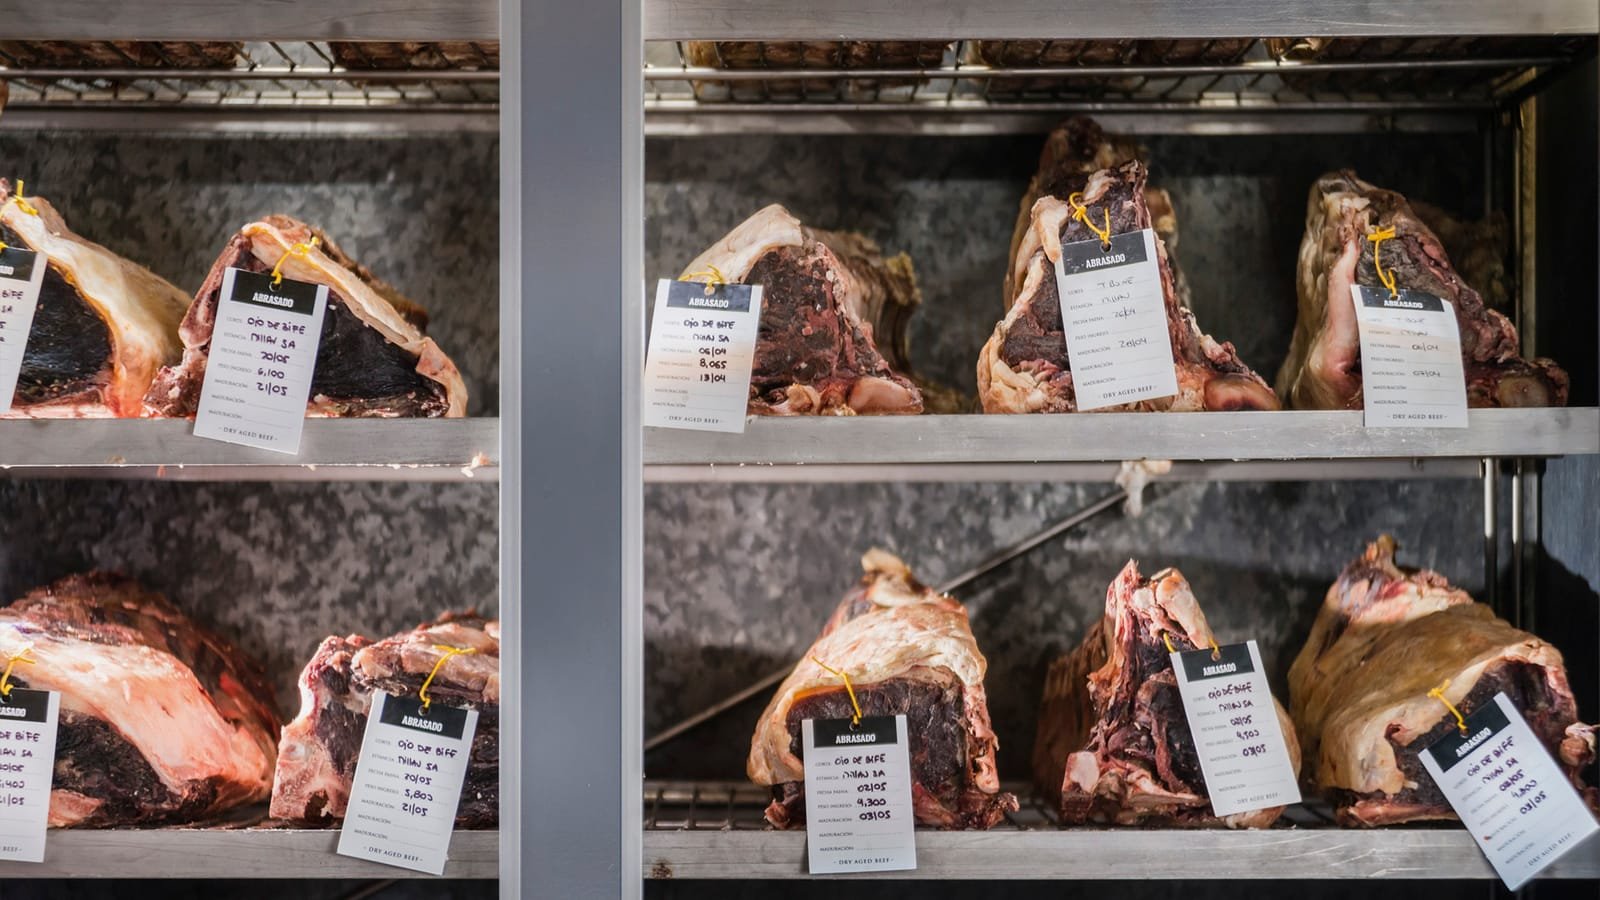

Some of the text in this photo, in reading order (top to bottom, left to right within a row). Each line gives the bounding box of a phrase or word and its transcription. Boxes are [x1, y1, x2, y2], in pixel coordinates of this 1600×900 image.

[1086, 254, 1126, 268] ABRASADO
[252, 292, 294, 308] ABRASADO
[689, 298, 729, 308] ABRASADO
[281, 339, 296, 349] SA
[698, 346, 727, 357] 06/04
[699, 374, 726, 384] 13/04
[257, 382, 288, 396] 21/05
[1103, 391, 1116, 399] DRY
[1118, 387, 1136, 396] AGED
[238, 430, 257, 438] AGED
[259, 433, 274, 441] BEEF
[1203, 663, 1236, 676] ABRASADO
[402, 716, 443, 732] ABRASADO
[836, 734, 876, 744] ABRASADO
[1456, 727, 1492, 757] ABRASADO
[426, 762, 438, 772] SA
[404, 772, 432, 785] 20/05
[857, 782, 887, 793] 02/05
[402, 802, 428, 817] 21/05
[859, 810, 891, 821] 03/05
[368, 846, 419, 862] DRY AGED BEEF
